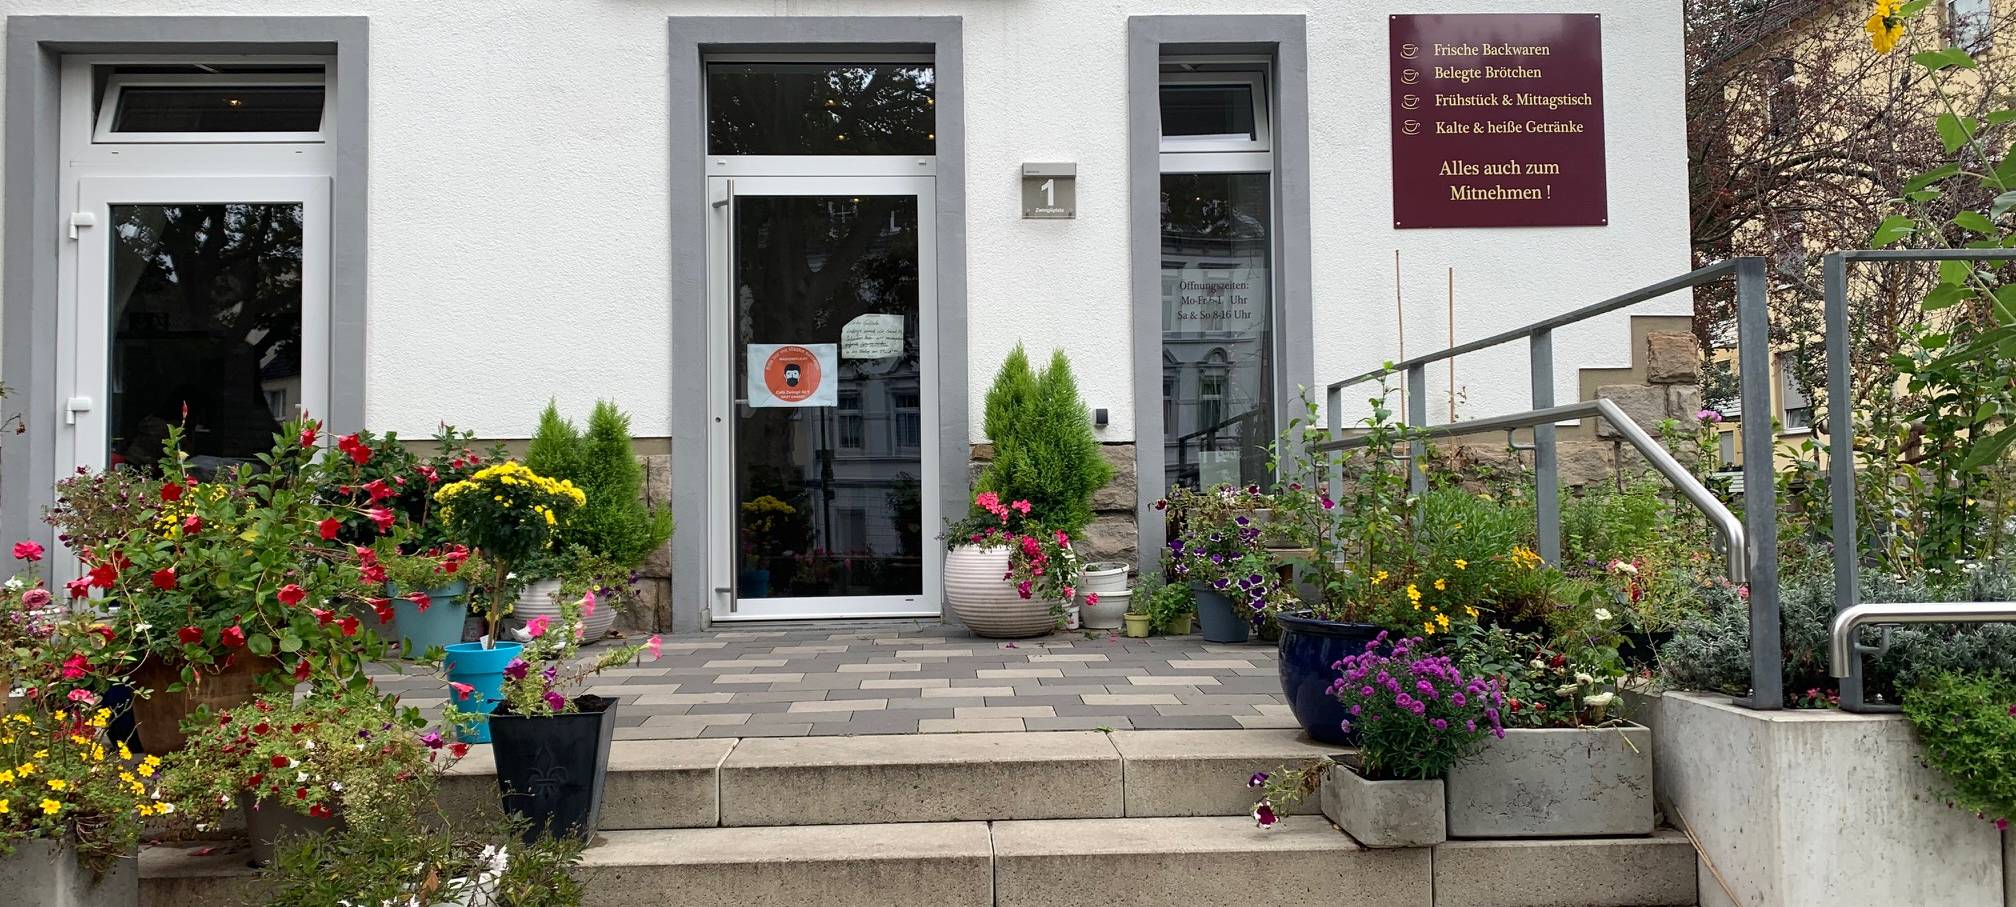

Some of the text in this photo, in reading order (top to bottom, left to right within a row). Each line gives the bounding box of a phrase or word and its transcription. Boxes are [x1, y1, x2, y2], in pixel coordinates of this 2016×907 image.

[1434, 43, 1550, 56] Frische Backwaren
[1434, 66, 1542, 83] Belegte Brötchen
[1435, 93, 1592, 110] Frühstück & Mittagstisch
[1435, 120, 1584, 134] Kalte & heiße Getränke
[1439, 159, 1560, 176] Alles auch zum
[1041, 178, 1054, 206] 1
[1450, 184, 1552, 201] Mitnehmen !
[1230, 295, 1248, 305] Uhr
[1177, 310, 1187, 320] Sa
[1190, 311, 1198, 320] &
[1200, 310, 1211, 320] So
[1234, 310, 1252, 319] Uhr
